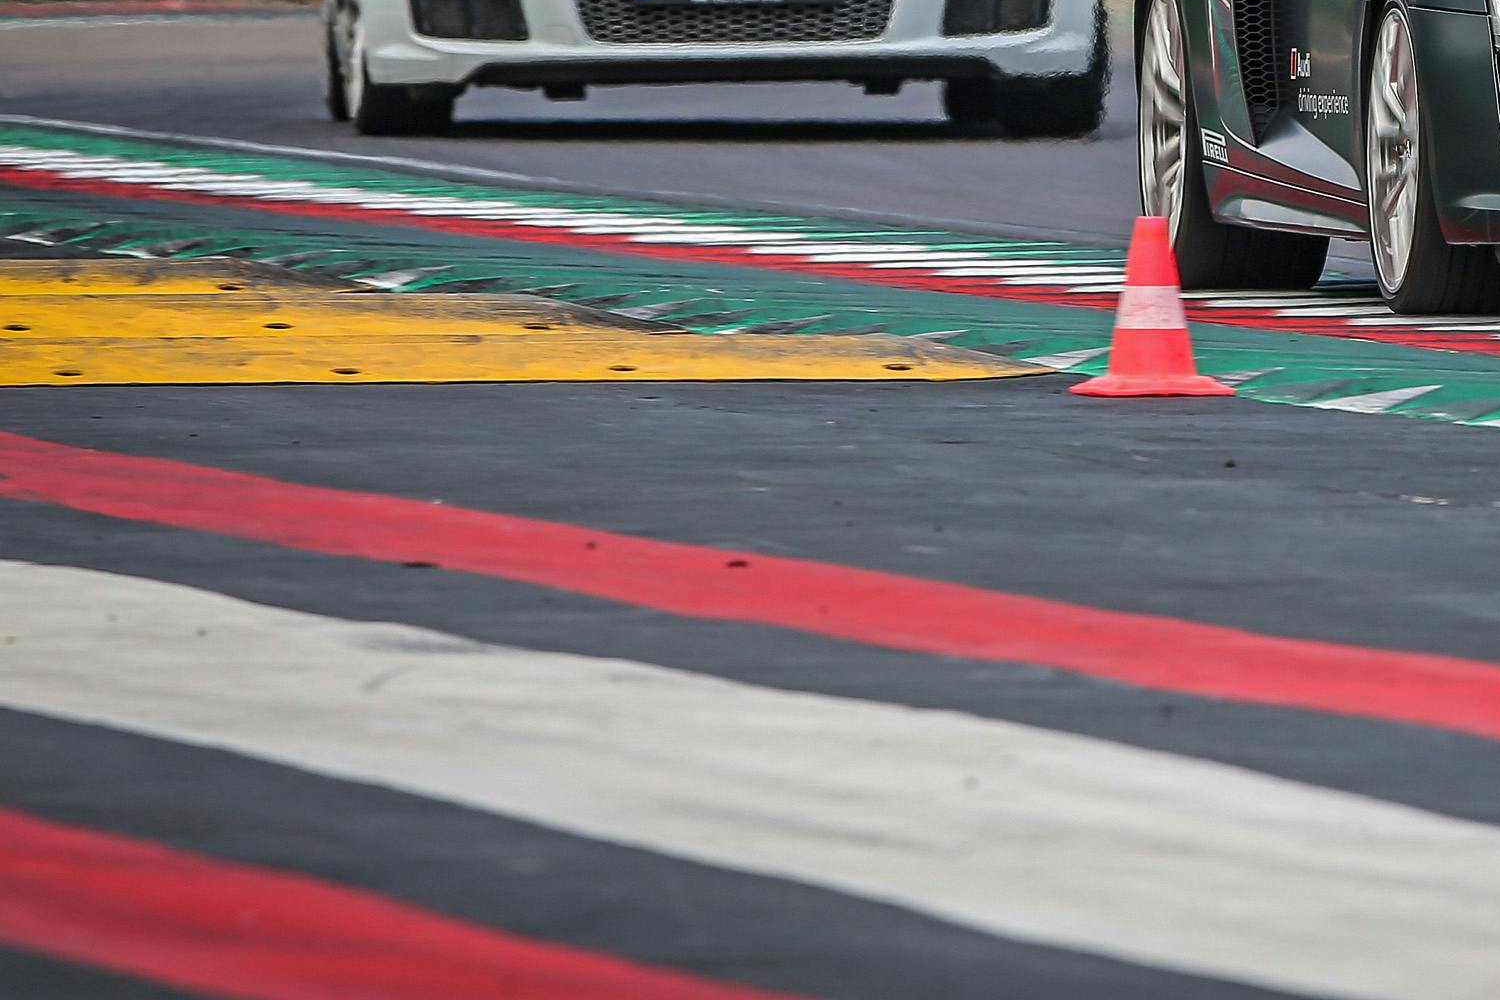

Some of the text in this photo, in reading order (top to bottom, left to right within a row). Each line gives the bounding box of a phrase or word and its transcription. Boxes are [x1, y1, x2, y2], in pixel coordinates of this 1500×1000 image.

[1297, 52, 1311, 77] Audi
[1298, 88, 1349, 119] driving experience
